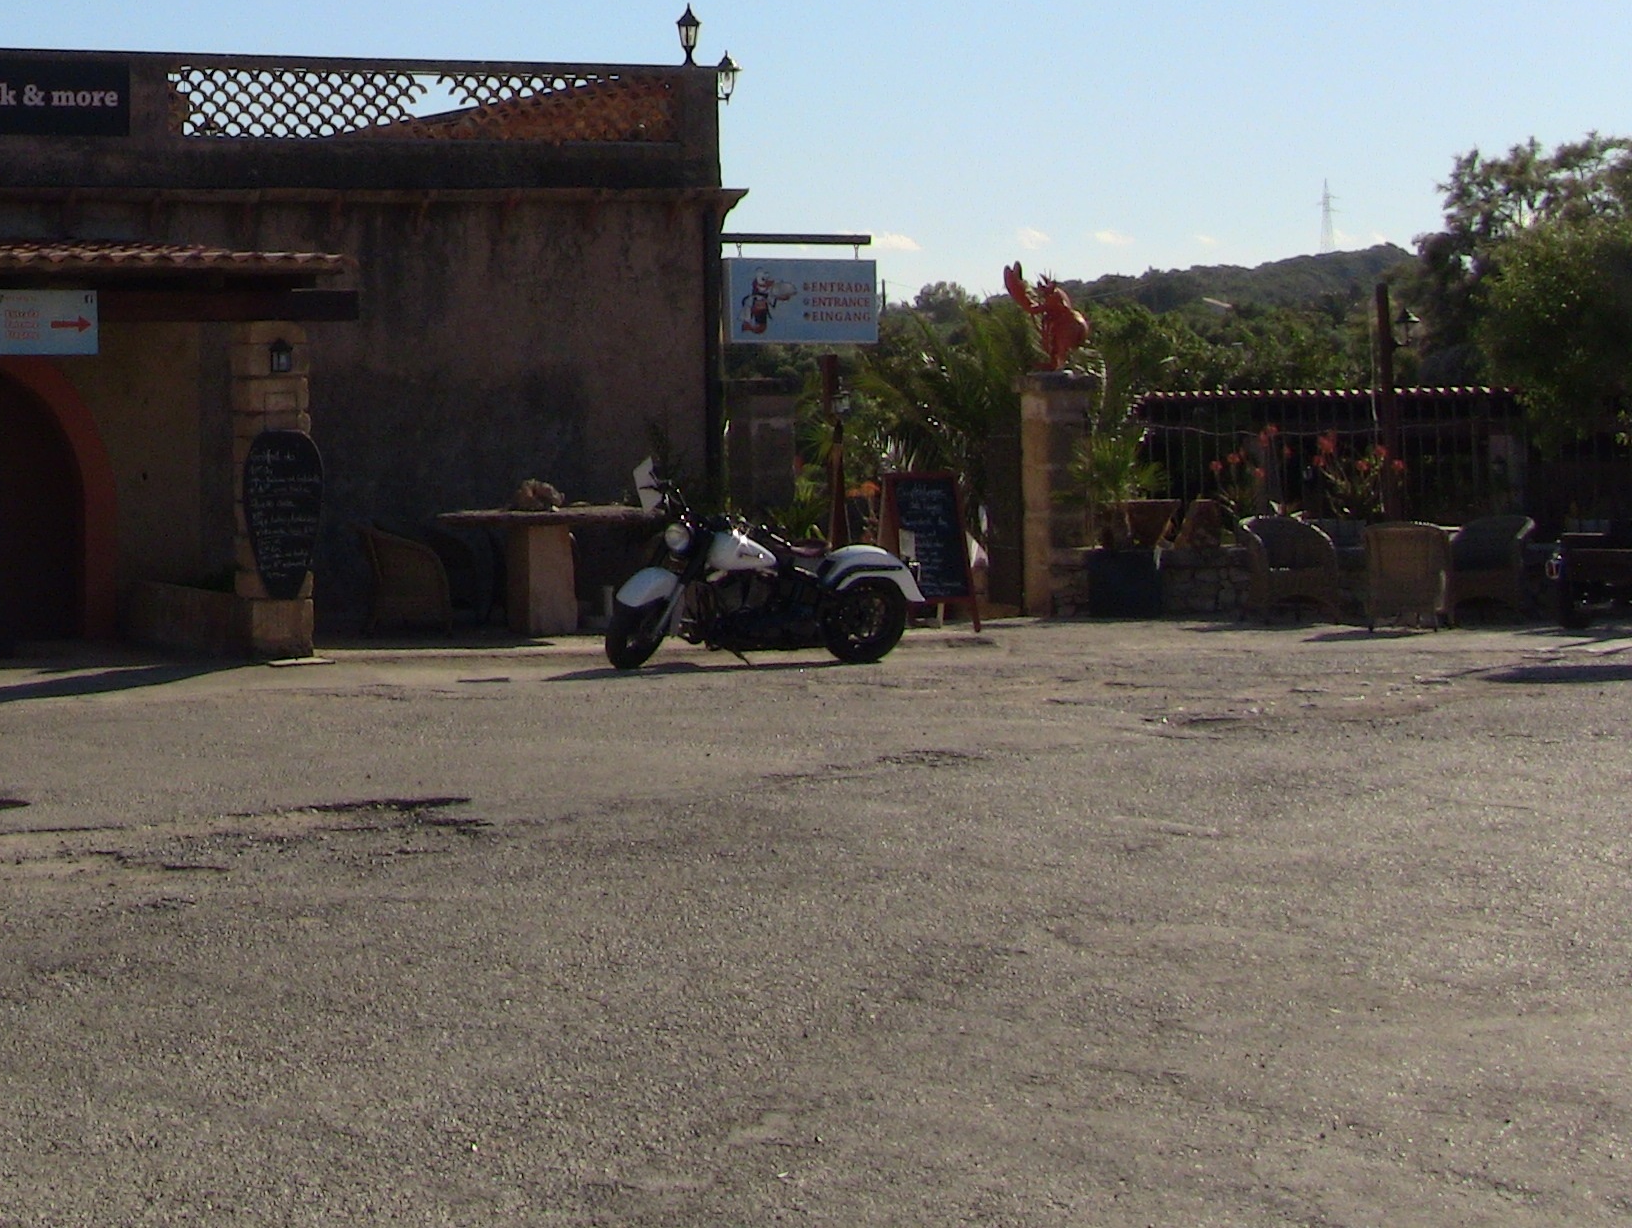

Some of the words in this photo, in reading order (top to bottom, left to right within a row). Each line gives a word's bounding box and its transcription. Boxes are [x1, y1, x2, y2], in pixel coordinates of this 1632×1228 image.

[23, 83, 45, 106] &
[51, 89, 118, 108] more
[811, 282, 871, 293] ENTRADA
[811, 296, 871, 307] ENTRANCE
[812, 311, 871, 322] EINGANG
